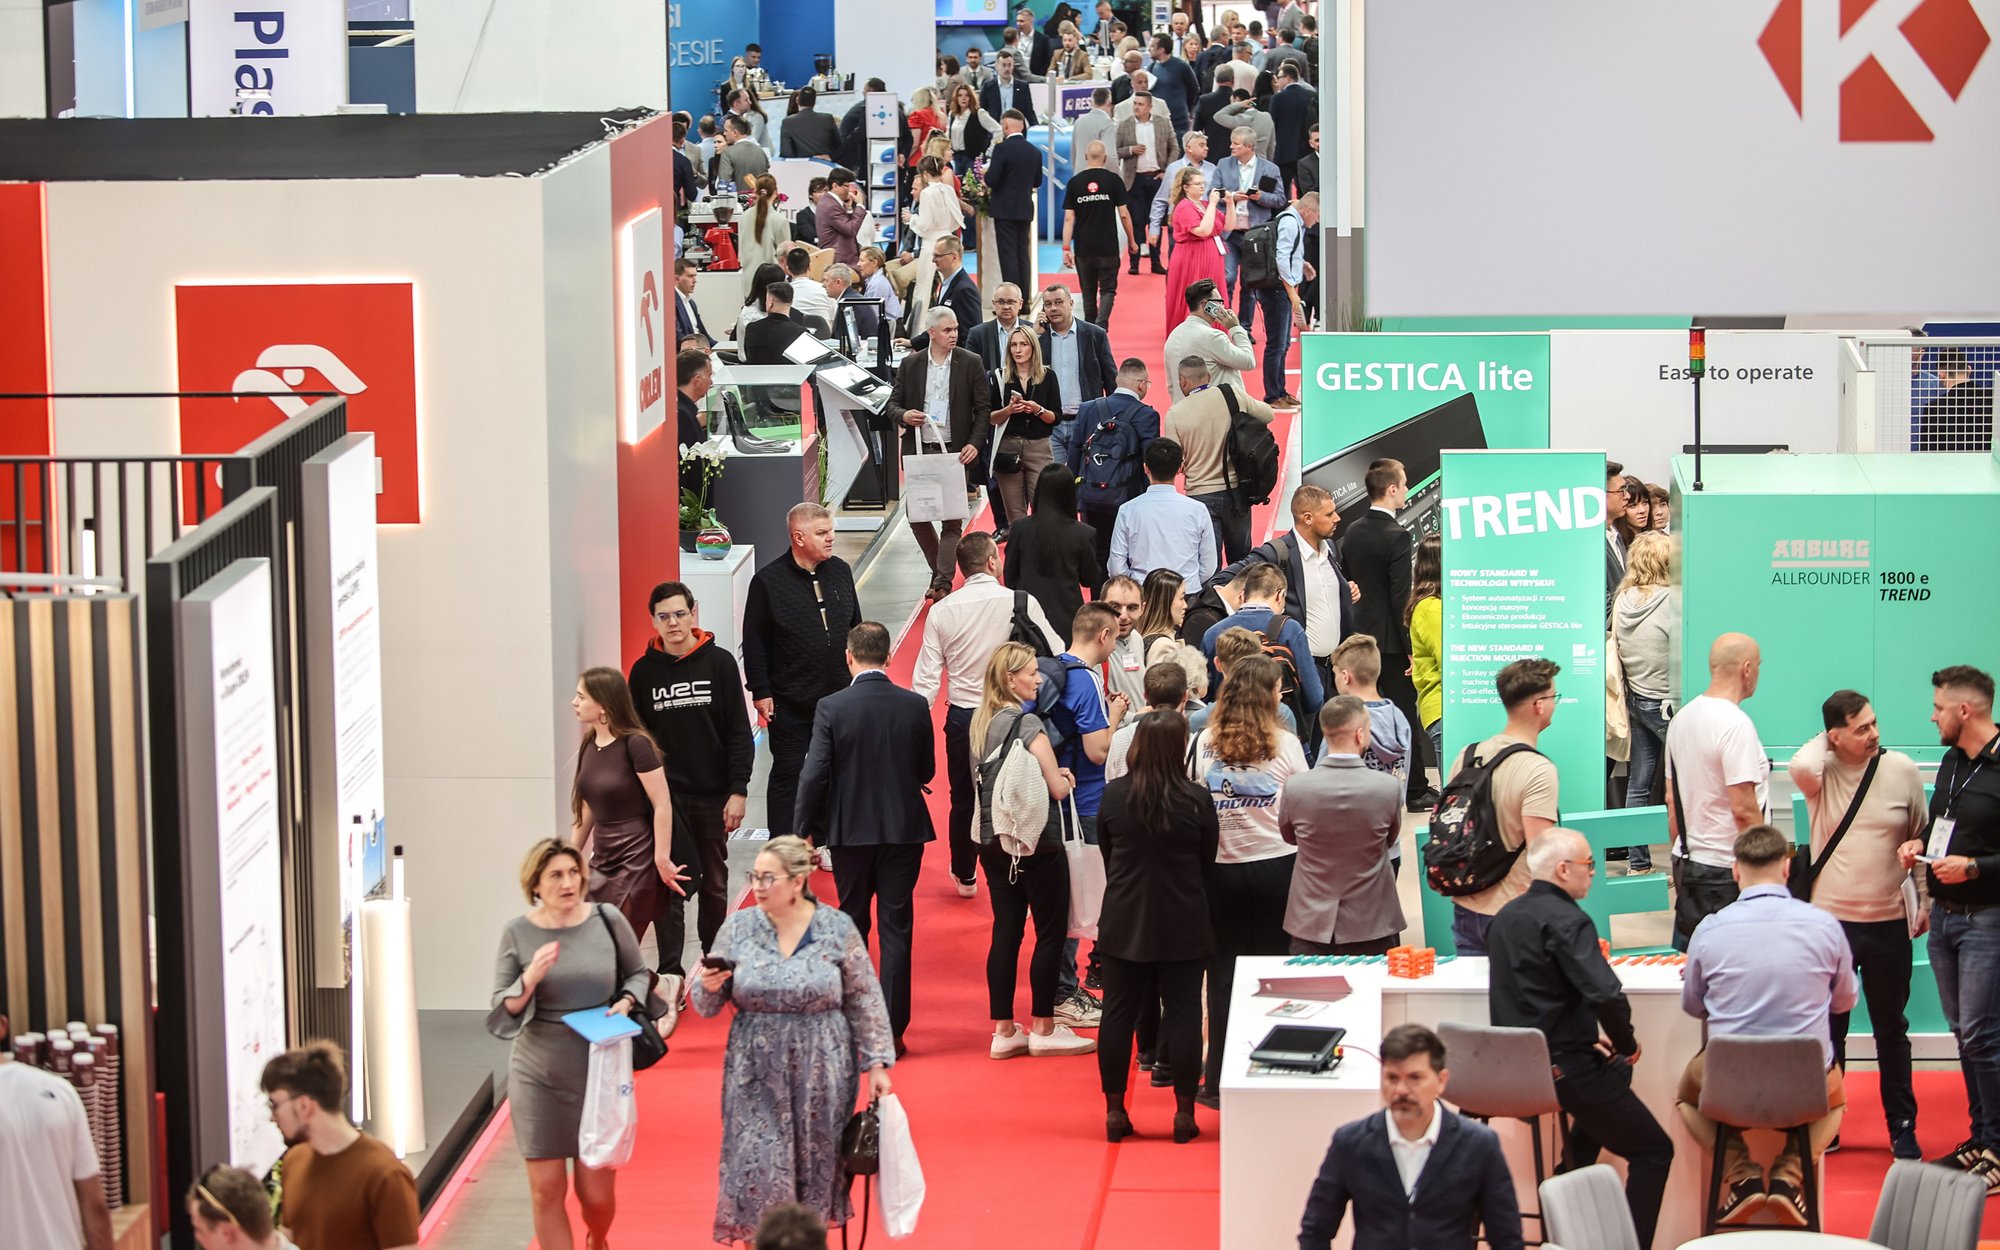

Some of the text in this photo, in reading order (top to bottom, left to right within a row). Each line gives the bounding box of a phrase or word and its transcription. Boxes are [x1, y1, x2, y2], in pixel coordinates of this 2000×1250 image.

[1077, 193, 1110, 204] OCHRONA
[1316, 361, 1533, 391] GESTICA lite
[1659, 364, 1814, 385] Eas to operate
[639, 365, 662, 413] ORLEN
[1441, 486, 1608, 540] TREND
[1771, 539, 1870, 559] ARBURG
[1450, 569, 1539, 577] NOWY STANDARD W
[1771, 572, 1929, 585] ALLROUNDER 1800 e
[1461, 594, 1487, 603] System
[1488, 594, 1538, 603] automatyzacji
[1880, 588, 1931, 602] TREND
[1461, 613, 1547, 622] Ekonomiczna produkcja
[1461, 622, 1497, 632] Intuicyjne
[1538, 622, 1569, 630] GESTICA
[1570, 622, 1583, 630] lite
[1450, 644, 1545, 652] THE NEW STANDARD IN
[1450, 654, 1492, 662] INJECTION
[1461, 669, 1492, 677] Turnkey
[651, 680, 712, 701] WRC
